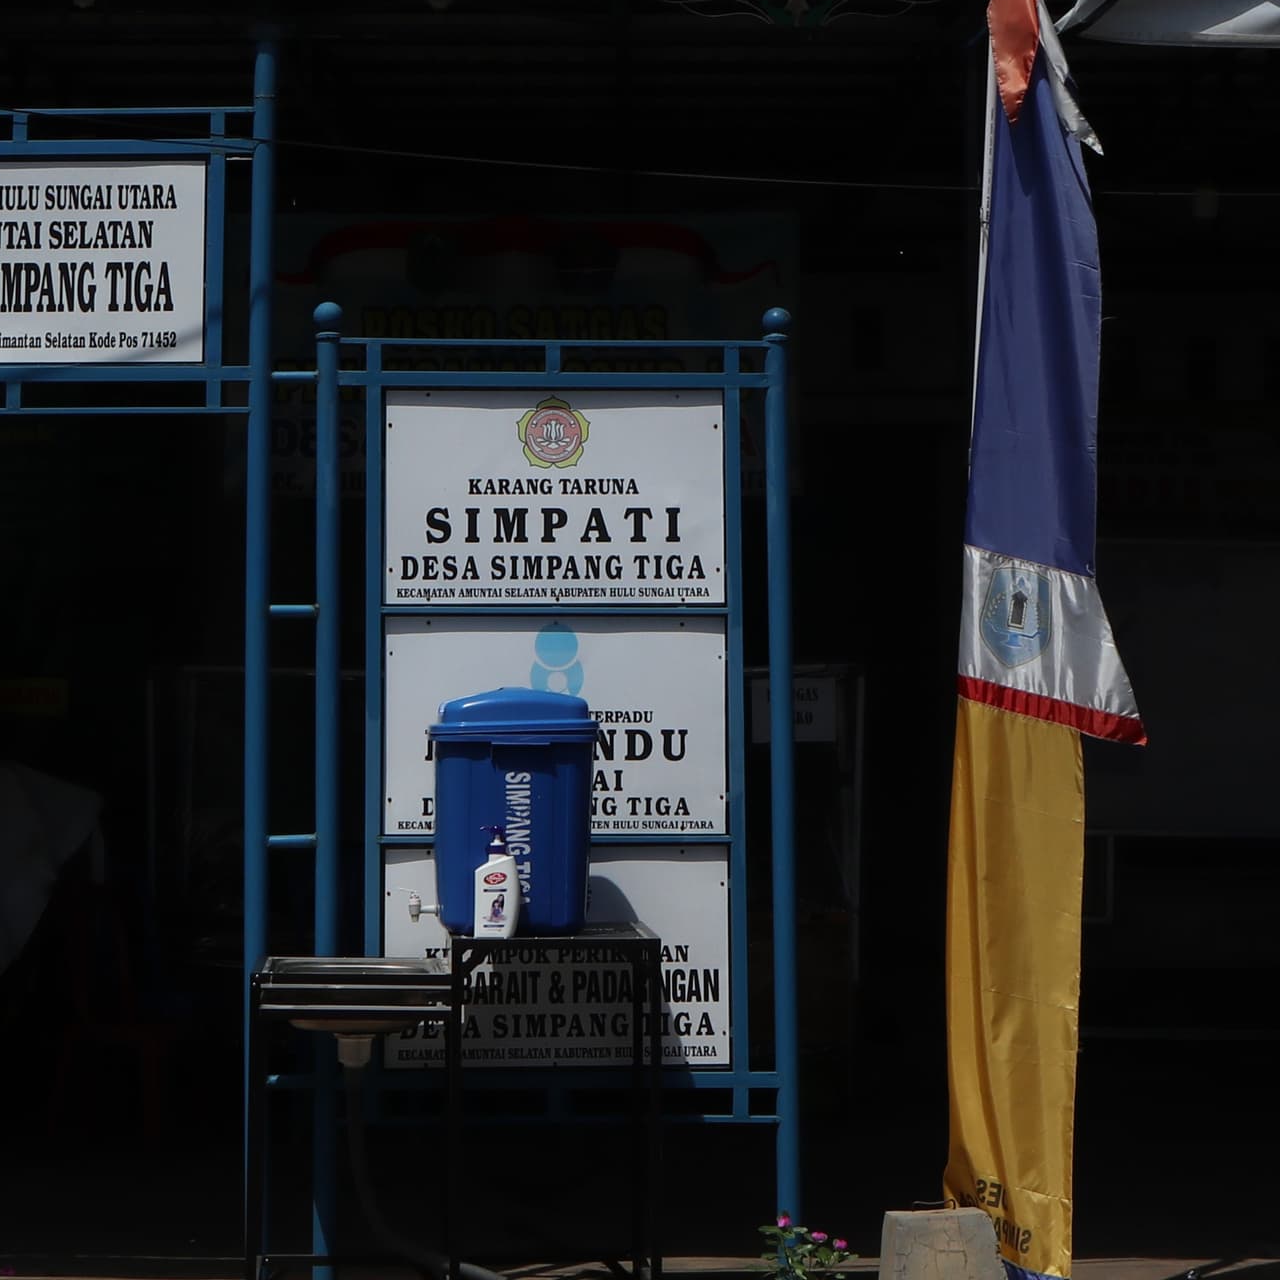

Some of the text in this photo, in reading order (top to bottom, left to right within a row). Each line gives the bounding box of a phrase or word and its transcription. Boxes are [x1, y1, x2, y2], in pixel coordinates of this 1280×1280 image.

[45, 185, 114, 210] SUNGAI
[118, 184, 177, 210] UTARA
[48, 221, 153, 249] SELATAN
[104, 261, 174, 313] TIGA
[44, 332, 87, 349] Selatan
[88, 332, 117, 349] Kode
[118, 332, 139, 349] Pos
[141, 331, 177, 348] 71452
[468, 478, 639, 495] KARANG TARUNA
[425, 507, 681, 544] SIMPATI
[401, 555, 706, 580] DESA SIMPANG TIGA
[397, 587, 710, 598] KECAMATAN AMUNTAI SELATAN KABUPATEN HULU SUNGAI UTARA
[505, 771, 532, 856] SIMPANG
[626, 797, 690, 816] TIGA
[613, 820, 640, 830] HULU
[642, 820, 679, 830] SUNGAI
[679, 820, 714, 830] UTARA
[548, 971, 565, 1004] &
[493, 1013, 630, 1038] SIMPANG
[508, 1047, 552, 1060] SELATAN
[554, 1046, 611, 1059] KABUPATEN
[684, 1046, 717, 1057] UTARA
